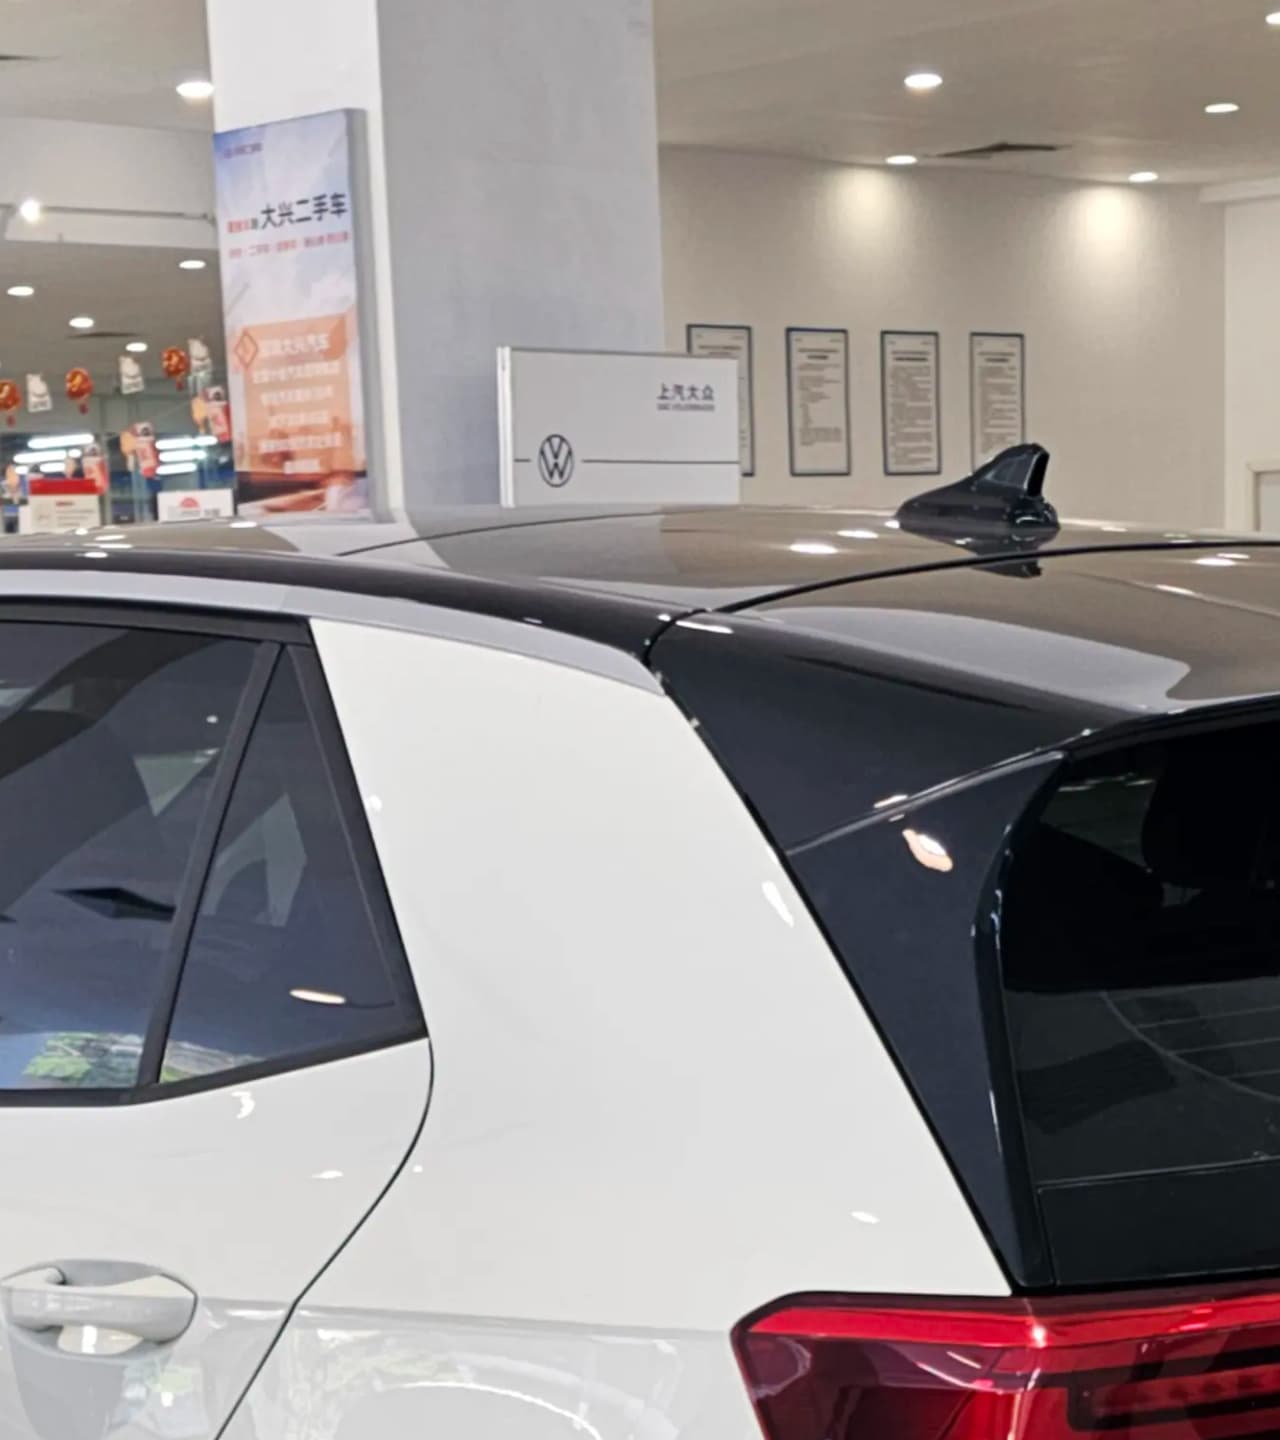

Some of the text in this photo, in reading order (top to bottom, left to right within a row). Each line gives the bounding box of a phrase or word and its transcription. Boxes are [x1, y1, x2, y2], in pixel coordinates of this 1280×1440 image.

[261, 192, 348, 230] 大兴二手车
